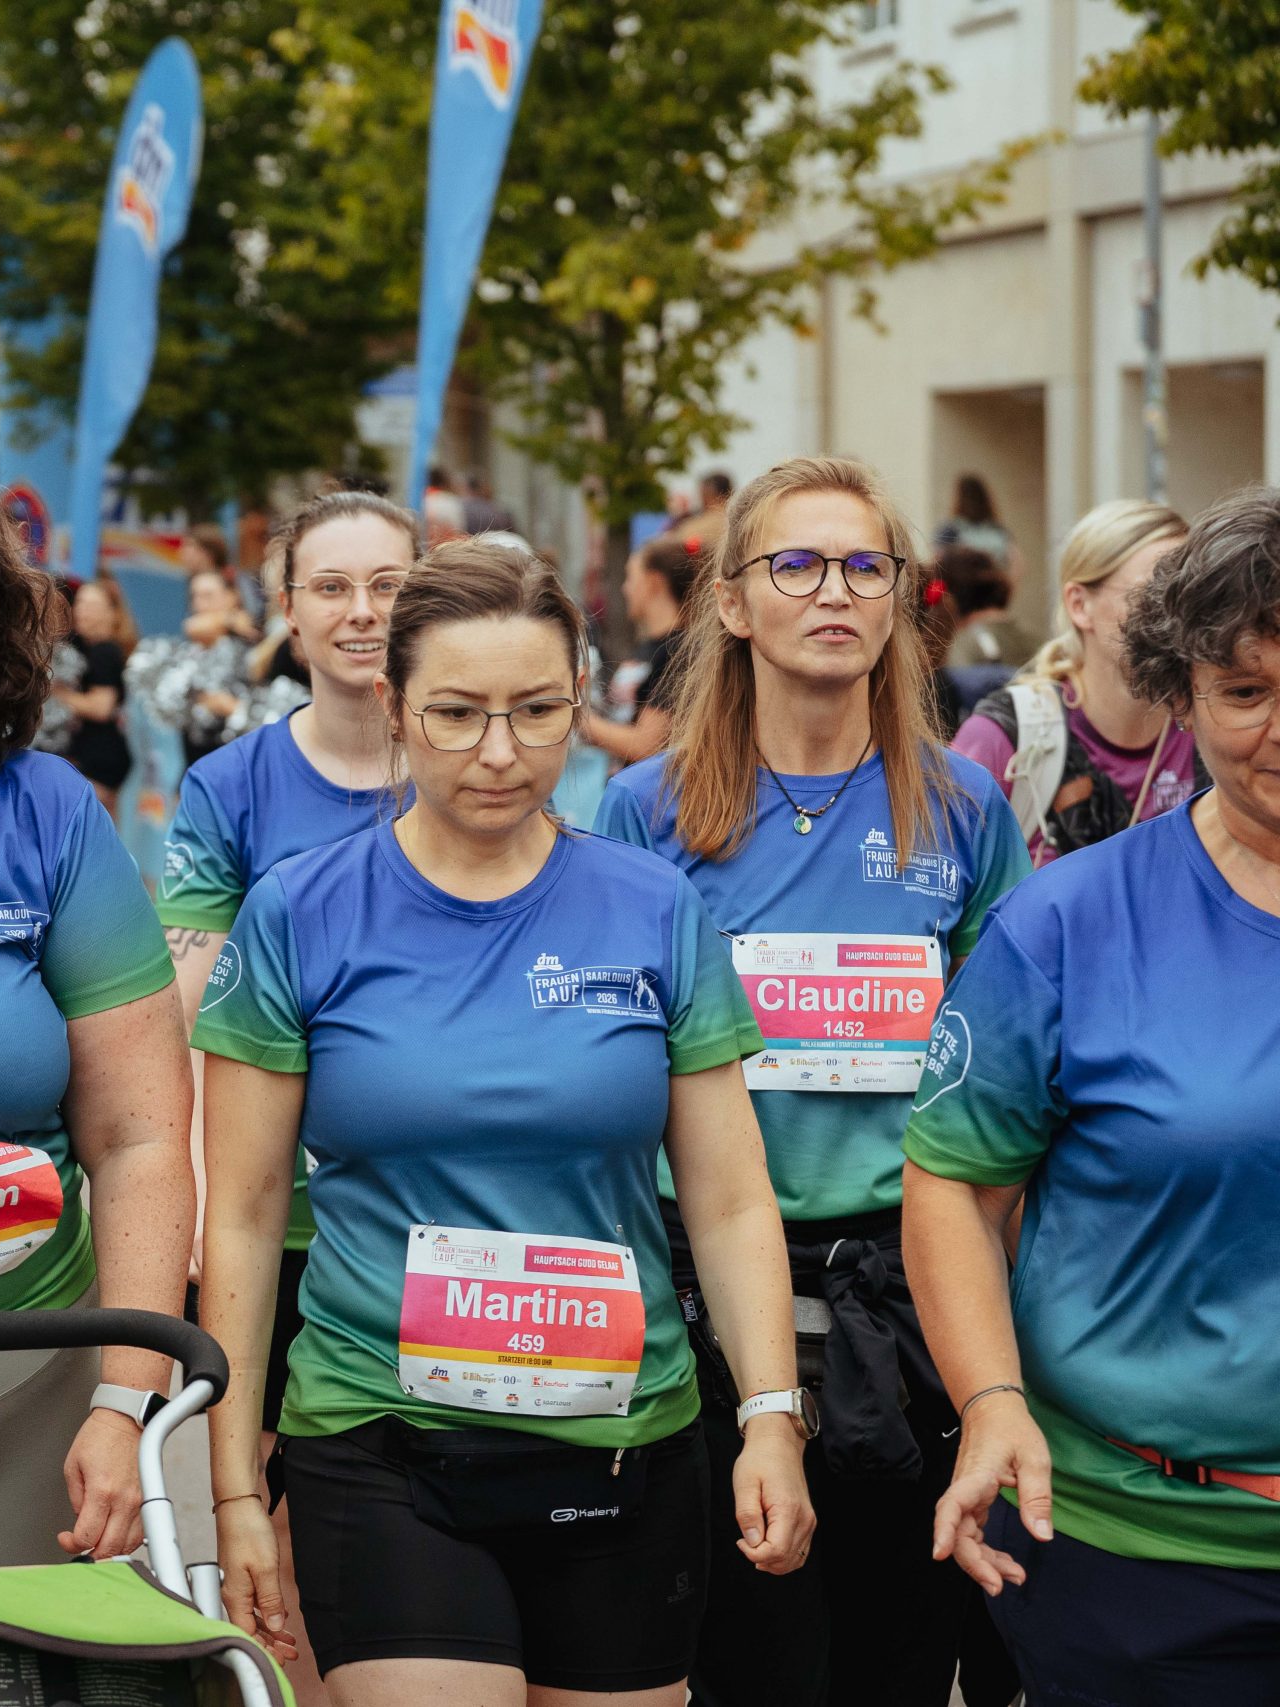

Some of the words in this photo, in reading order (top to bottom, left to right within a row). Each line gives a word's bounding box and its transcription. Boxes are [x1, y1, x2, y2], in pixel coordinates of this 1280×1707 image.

[868, 828, 885, 840] dm
[866, 850, 898, 863] FRAUEN
[537, 953, 560, 965] dm
[845, 951, 884, 961] HAUPTSACH
[535, 972, 580, 989] FRAUEN
[586, 971, 632, 984] SAARLOUIS
[537, 984, 580, 1004] LAUF
[596, 992, 618, 1004] 2026
[756, 978, 926, 1014] Claudine
[823, 1020, 865, 1037] 1452
[761, 1055, 778, 1064] dm
[434, 1253, 455, 1263] LAUF
[533, 1254, 577, 1267] HAUPTSACH
[577, 1258, 597, 1268] GUDD
[597, 1259, 619, 1271] GELAAF
[445, 1280, 608, 1329] Martina
[507, 1333, 545, 1353] 459
[498, 1355, 526, 1365] STARTZEIT
[541, 1358, 552, 1366] UHR
[431, 1366, 448, 1377] dm
[543, 1380, 569, 1388] Kaufland
[579, 1506, 620, 1517] Kalenji
